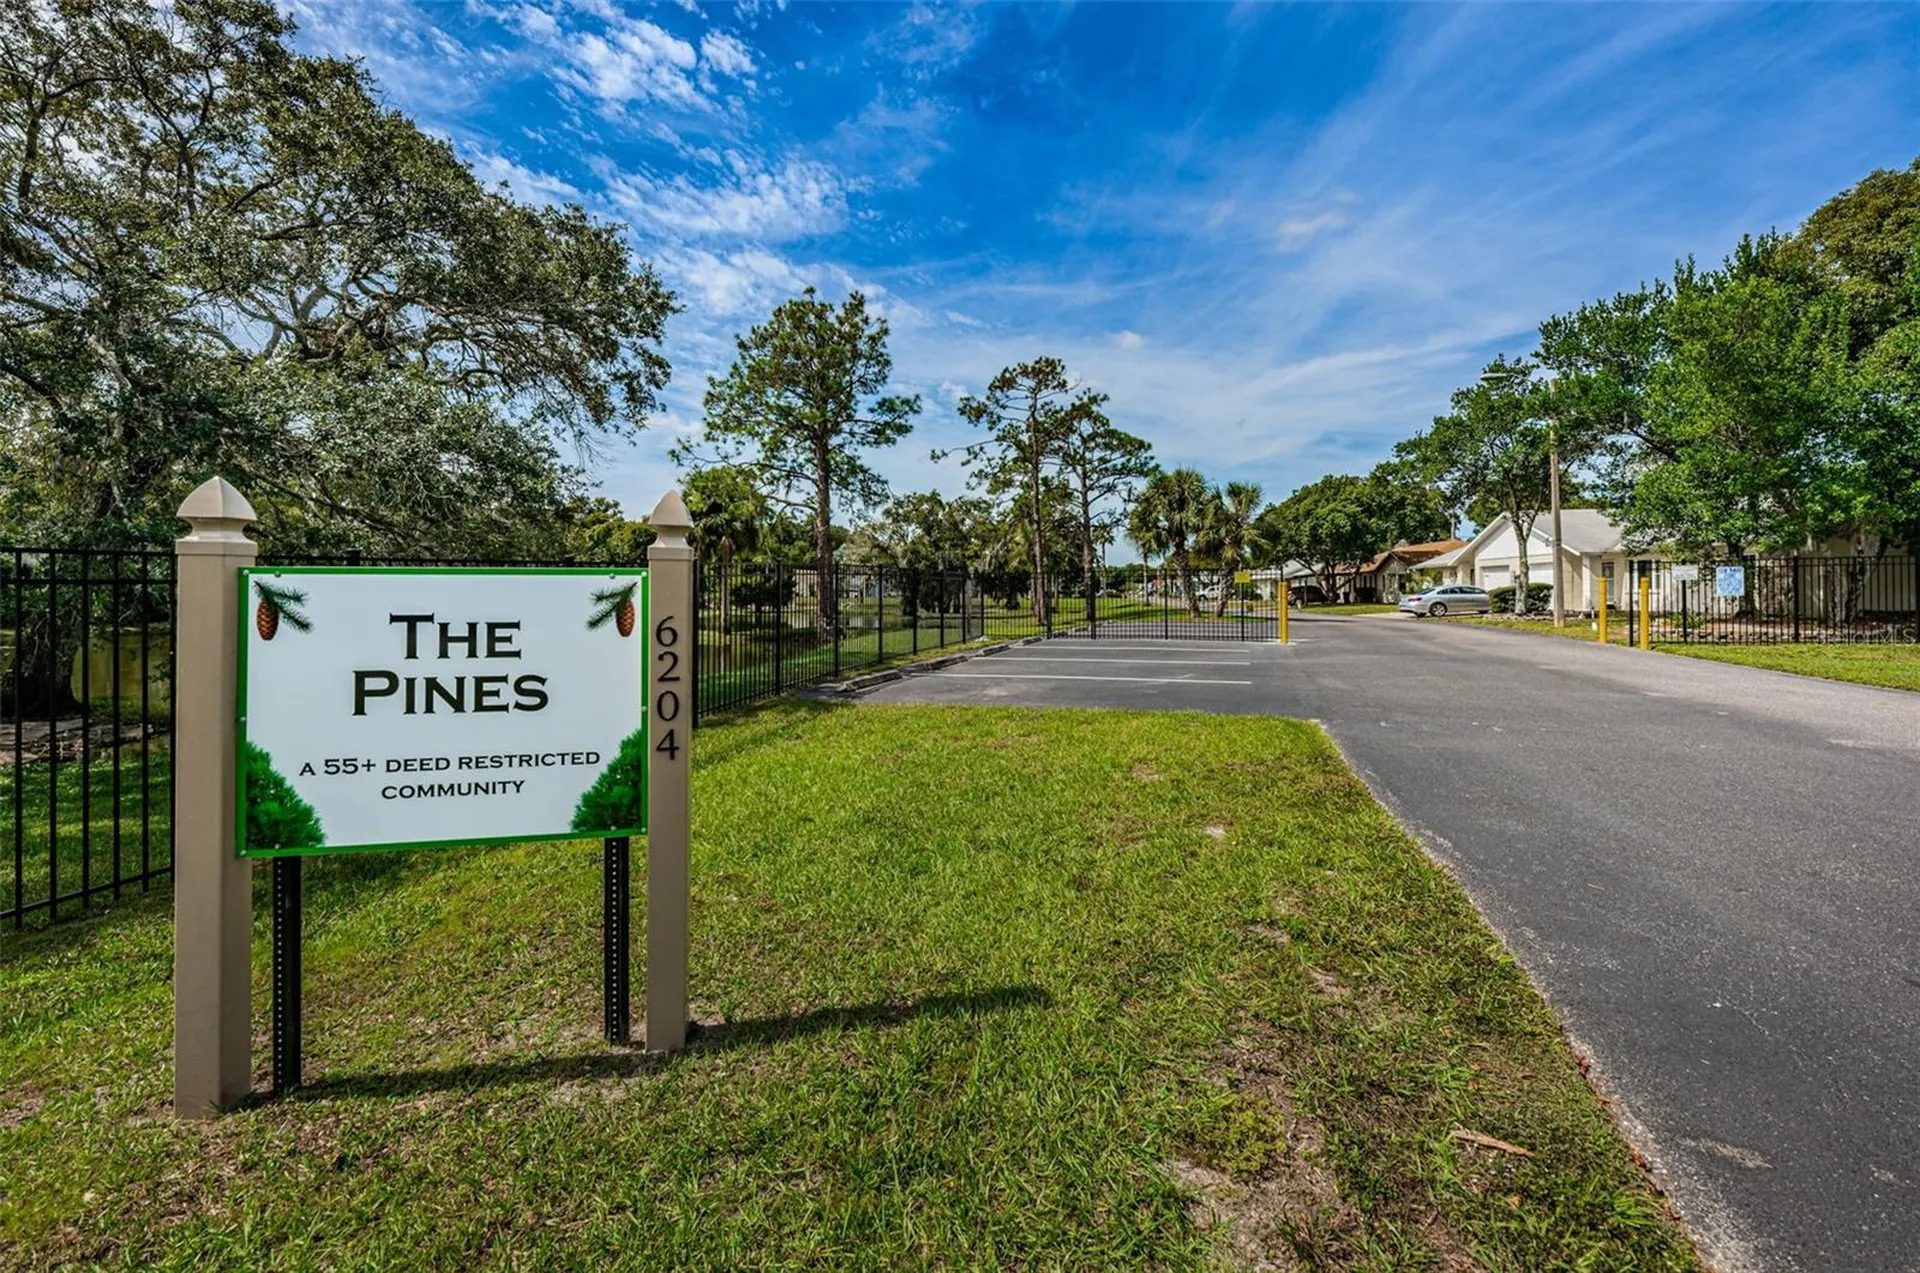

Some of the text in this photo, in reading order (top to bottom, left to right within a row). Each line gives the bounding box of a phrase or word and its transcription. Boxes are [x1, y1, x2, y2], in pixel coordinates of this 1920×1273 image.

[389, 612, 522, 660] THE
[352, 669, 550, 716] PINES
[655, 615, 681, 761] 6204
[299, 751, 601, 777] A 55+ DEED RESTRICTED
[381, 779, 525, 800] COMMUNITY
